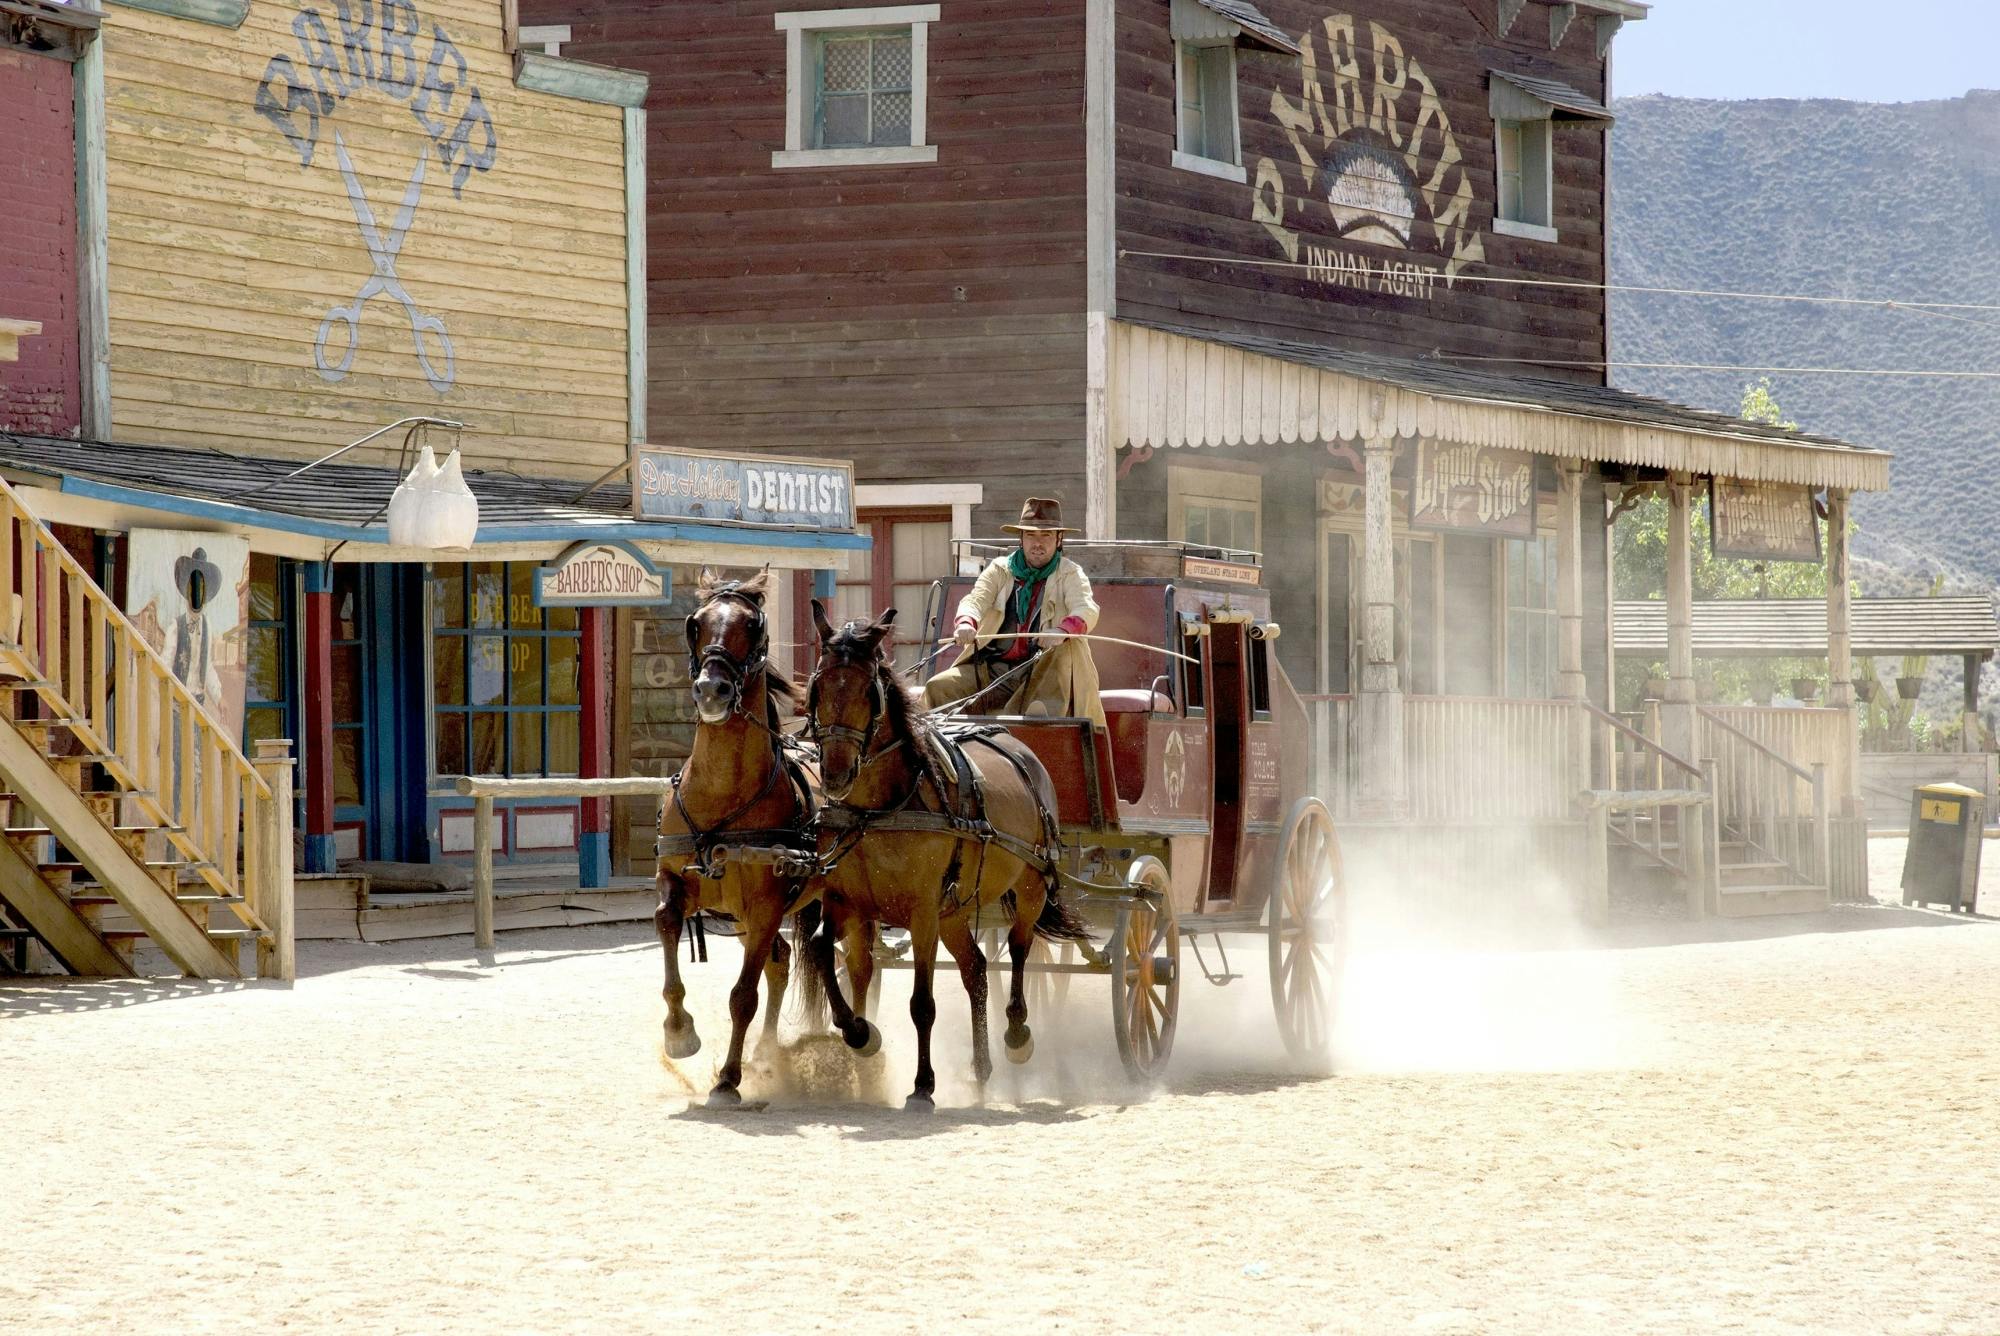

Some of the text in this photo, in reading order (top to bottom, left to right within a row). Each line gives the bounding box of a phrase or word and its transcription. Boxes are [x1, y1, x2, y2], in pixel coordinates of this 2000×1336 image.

[253, 0, 497, 200] BARBER
[1306, 246, 1438, 300] INDIAN AGENT
[640, 457, 678, 497] Doc
[746, 469, 845, 514] DENTIST
[1414, 440, 1530, 524] Liquor Store
[557, 559, 643, 594] BARBER'S SHOP
[482, 643, 531, 673] SHOP
